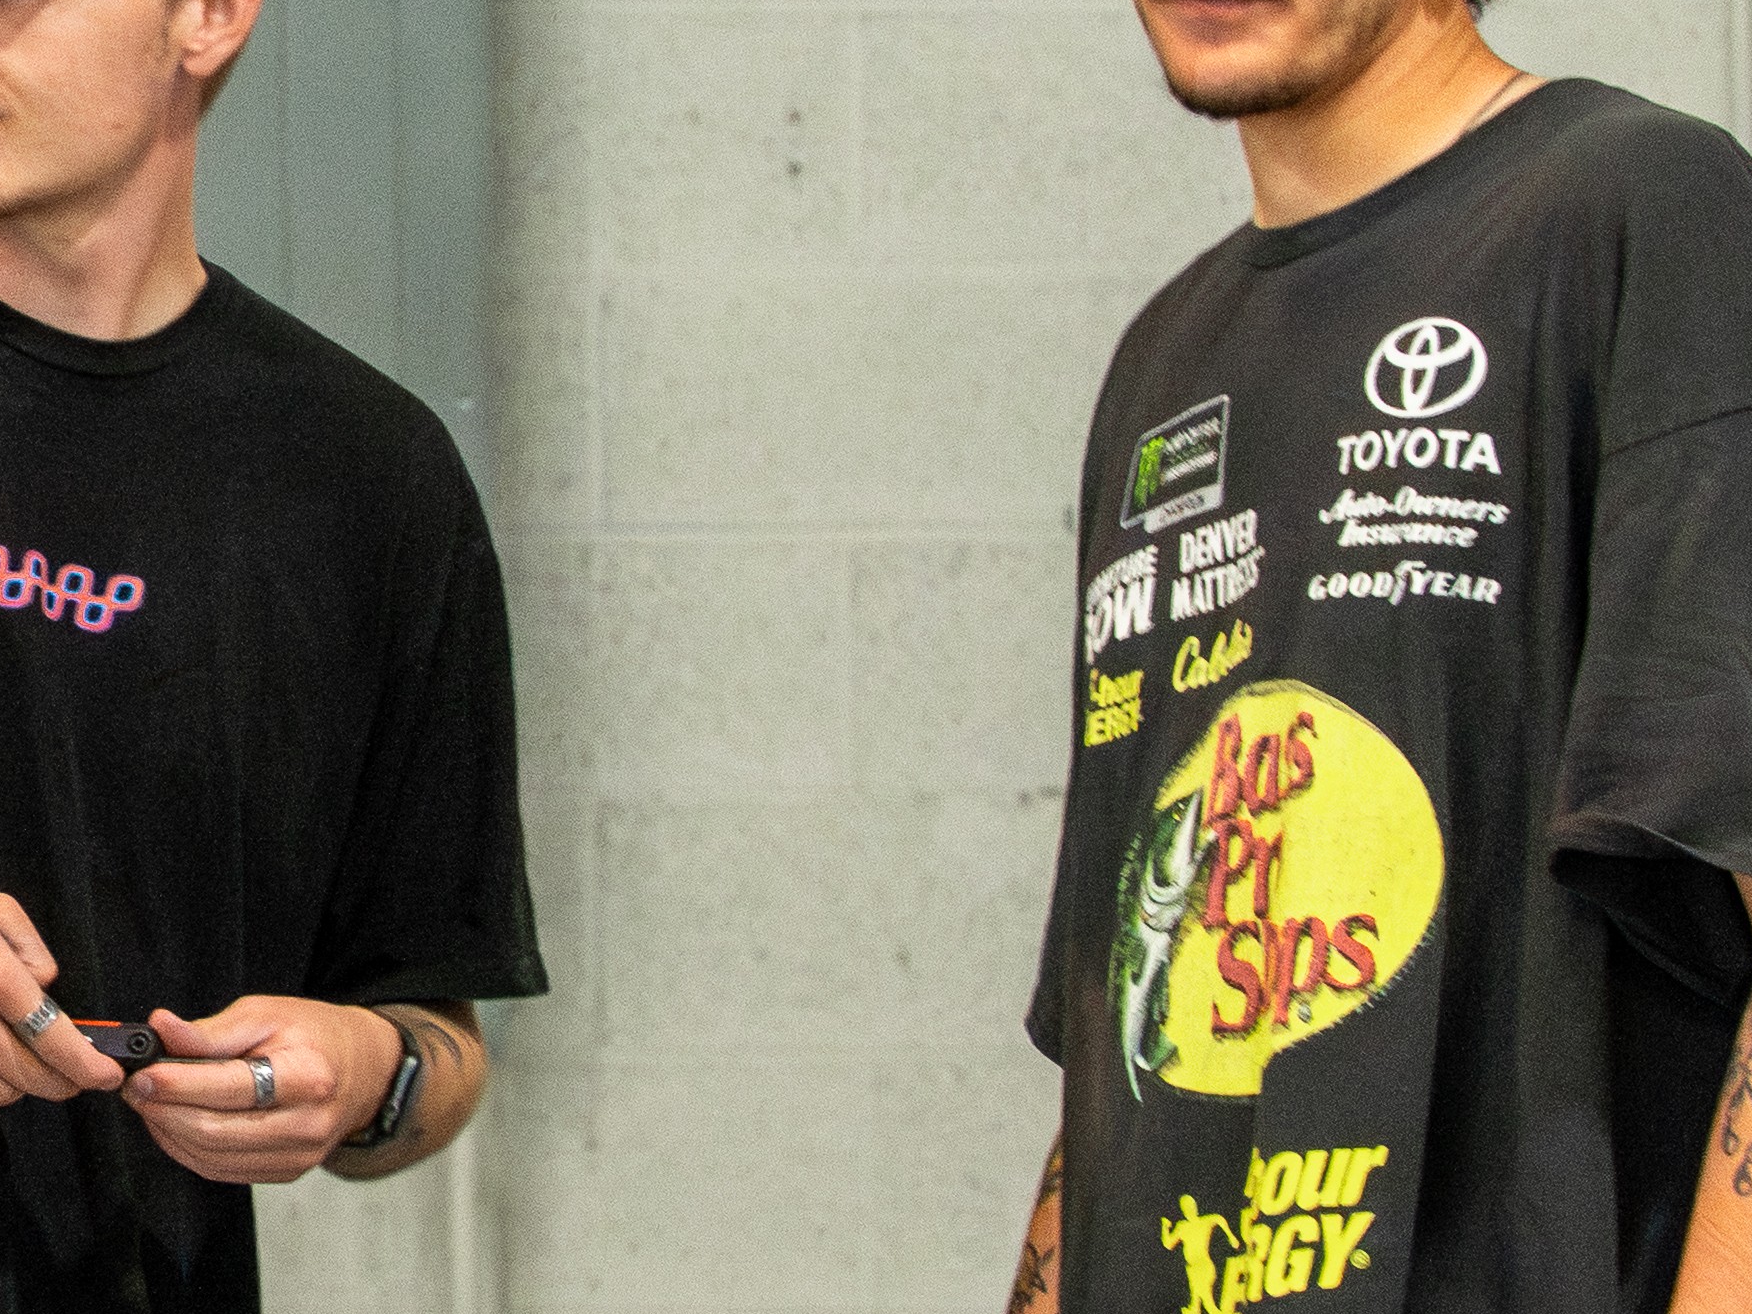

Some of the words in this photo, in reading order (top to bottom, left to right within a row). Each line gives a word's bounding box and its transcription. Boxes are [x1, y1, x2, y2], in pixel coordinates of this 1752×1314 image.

[1337, 427, 1502, 475] TOYOTA
[1318, 486, 1511, 524] Auto-Owners
[1337, 518, 1478, 548] Insurance
[1307, 560, 1502, 605] GOODYEAR
